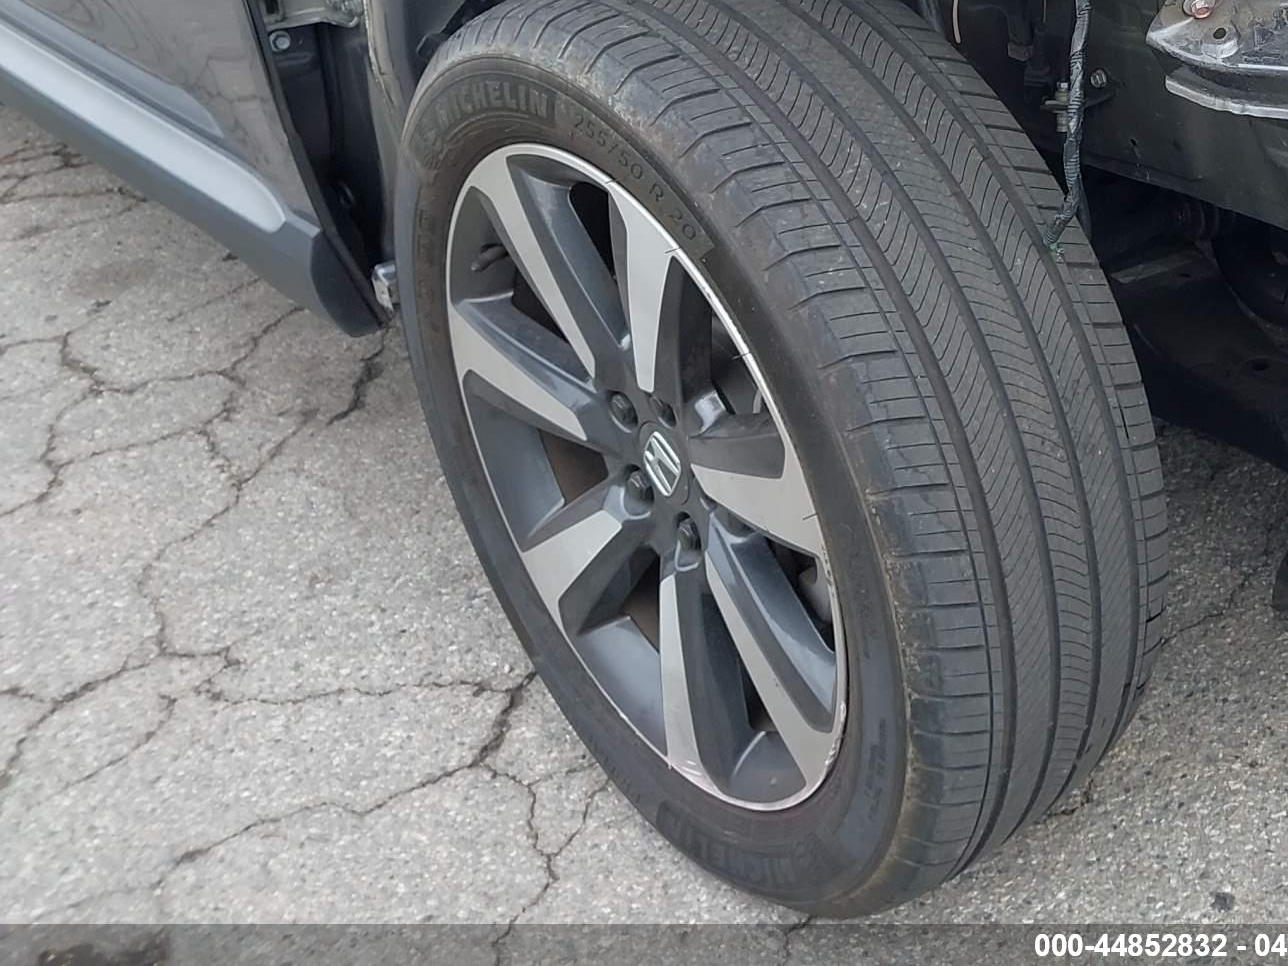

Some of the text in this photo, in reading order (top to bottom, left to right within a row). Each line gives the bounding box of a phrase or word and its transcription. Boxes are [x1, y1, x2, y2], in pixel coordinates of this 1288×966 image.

[433, 80, 548, 129] MICHELIN
[573, 113, 697, 241] 255/50 R 20
